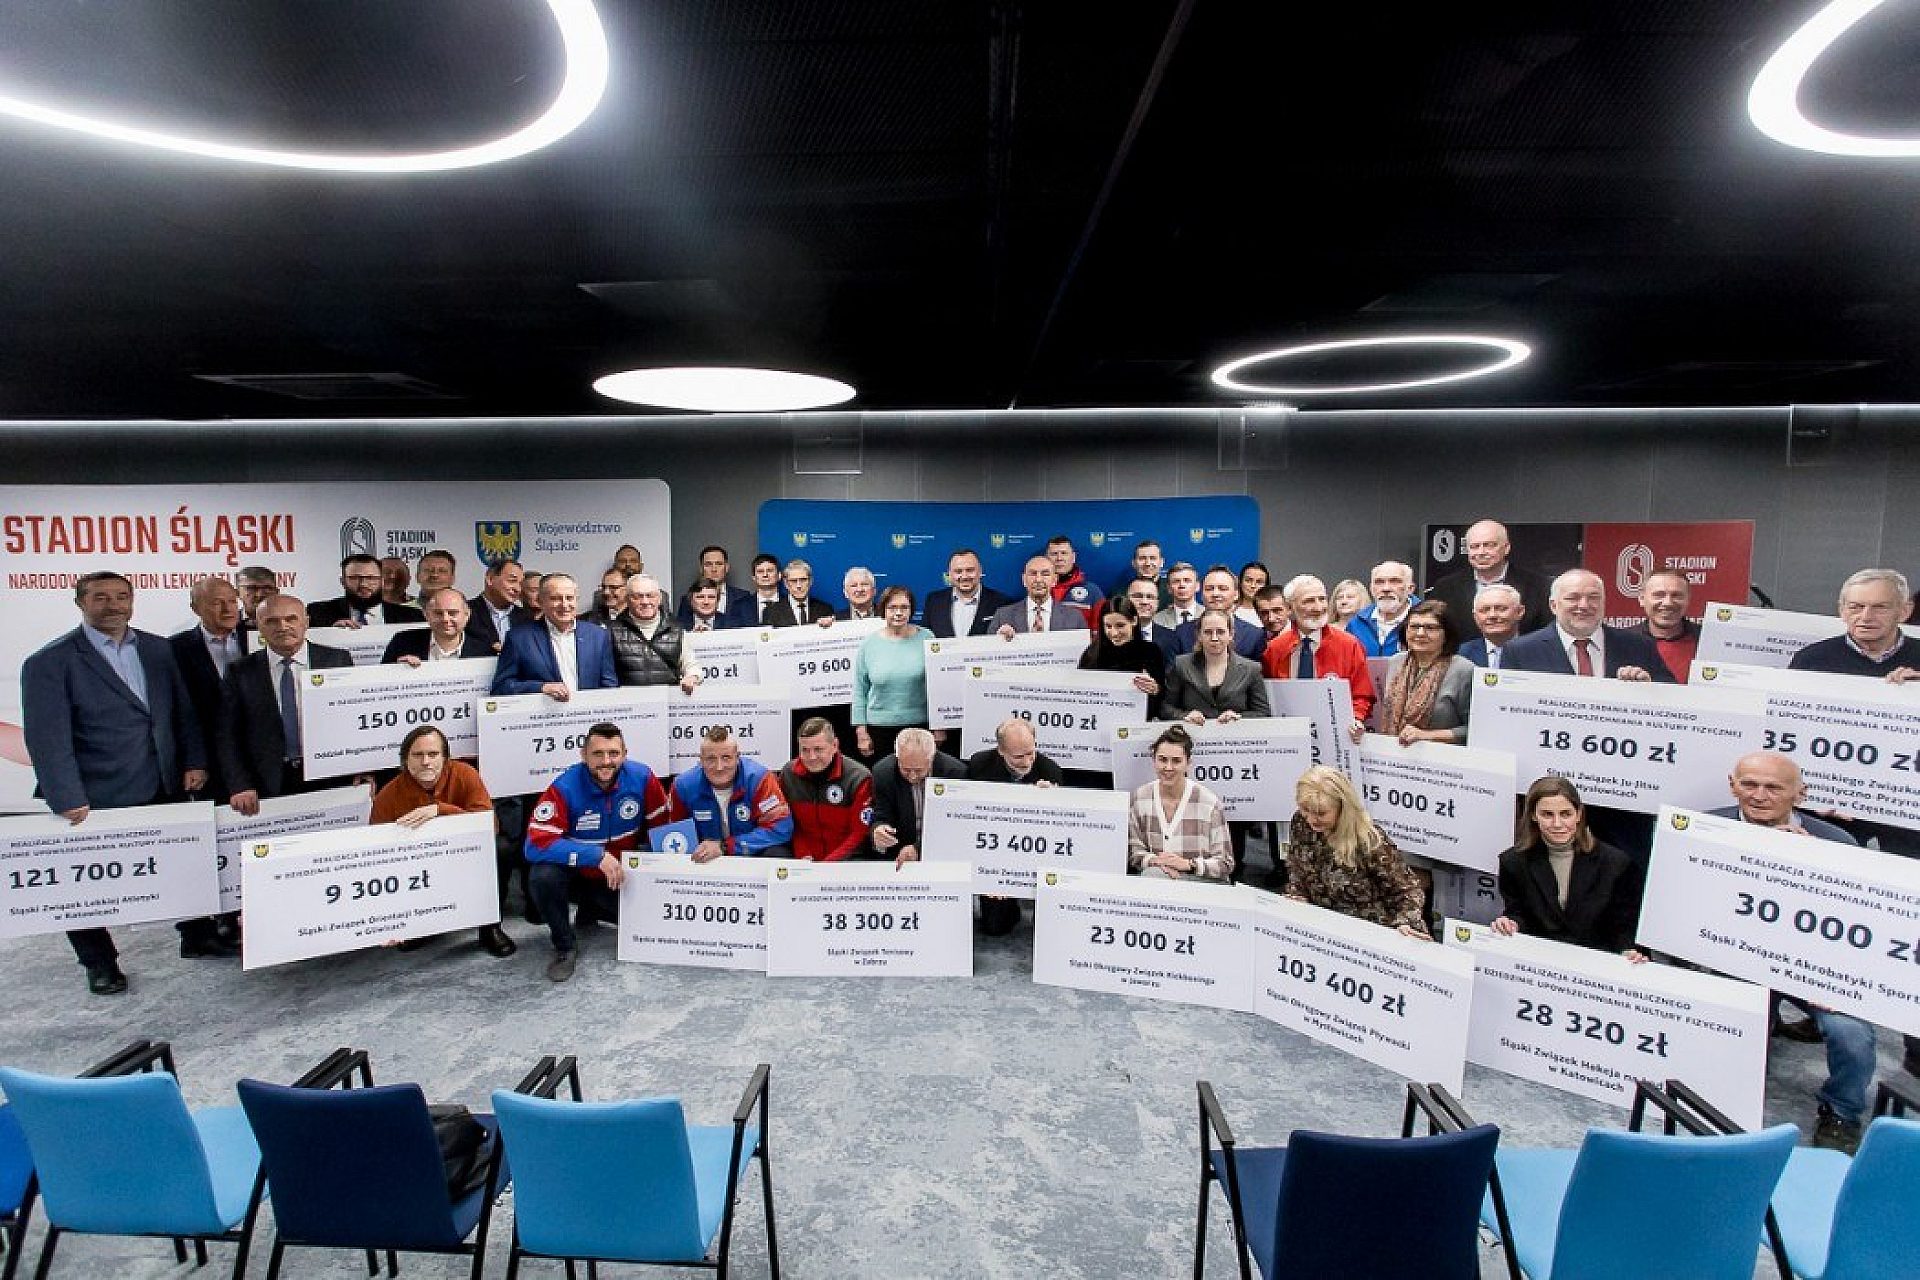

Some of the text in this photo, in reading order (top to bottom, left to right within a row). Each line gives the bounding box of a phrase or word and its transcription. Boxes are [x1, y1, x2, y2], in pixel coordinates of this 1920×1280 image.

[3, 506, 296, 567] STADION ŚLĄSKI
[386, 530, 436, 543] STADION
[533, 521, 622, 536] Województwo
[535, 538, 579, 554] Śląskie
[1665, 556, 1718, 570] STADION
[1686, 571, 1707, 584] SKI
[723, 663, 738, 677] zł
[797, 657, 851, 675] 59 600
[357, 701, 475, 730] 150 000 zł
[1037, 710, 1074, 728] 000
[1078, 714, 1098, 730] zł
[735, 722, 754, 737] zł
[532, 736, 559, 753] 73
[1538, 728, 1677, 764] 18 600 zł
[1762, 729, 1797, 752] 35
[1809, 736, 1878, 765] 000
[1240, 763, 1259, 781] zł
[1577, 772, 1618, 789] Związek
[1387, 789, 1428, 812] 000
[1434, 798, 1455, 818] zł
[975, 831, 1074, 856] 53 400 zł
[8, 855, 158, 889] 121 700 zł
[324, 869, 430, 904] 9 300 zł
[1867, 886, 1920, 905] PUBLICZ
[662, 902, 767, 926] 310 000 zł
[822, 911, 920, 931] 38 300 zł
[1734, 891, 1780, 923] 30
[1793, 908, 1873, 949] 000
[1090, 924, 1195, 955] 23 000 zł
[1699, 928, 1919, 1004] Śląski Związek Akrobatyki Sport
[1277, 954, 1405, 1017] 103 400 zł
[1783, 968, 1862, 1000] Katowicach
[1516, 998, 1669, 1057] 28 320 zł
[1500, 1036, 1532, 1053] Śląski
[1533, 1046, 1579, 1067] Związek
[1560, 1065, 1624, 1092] Katowicach
